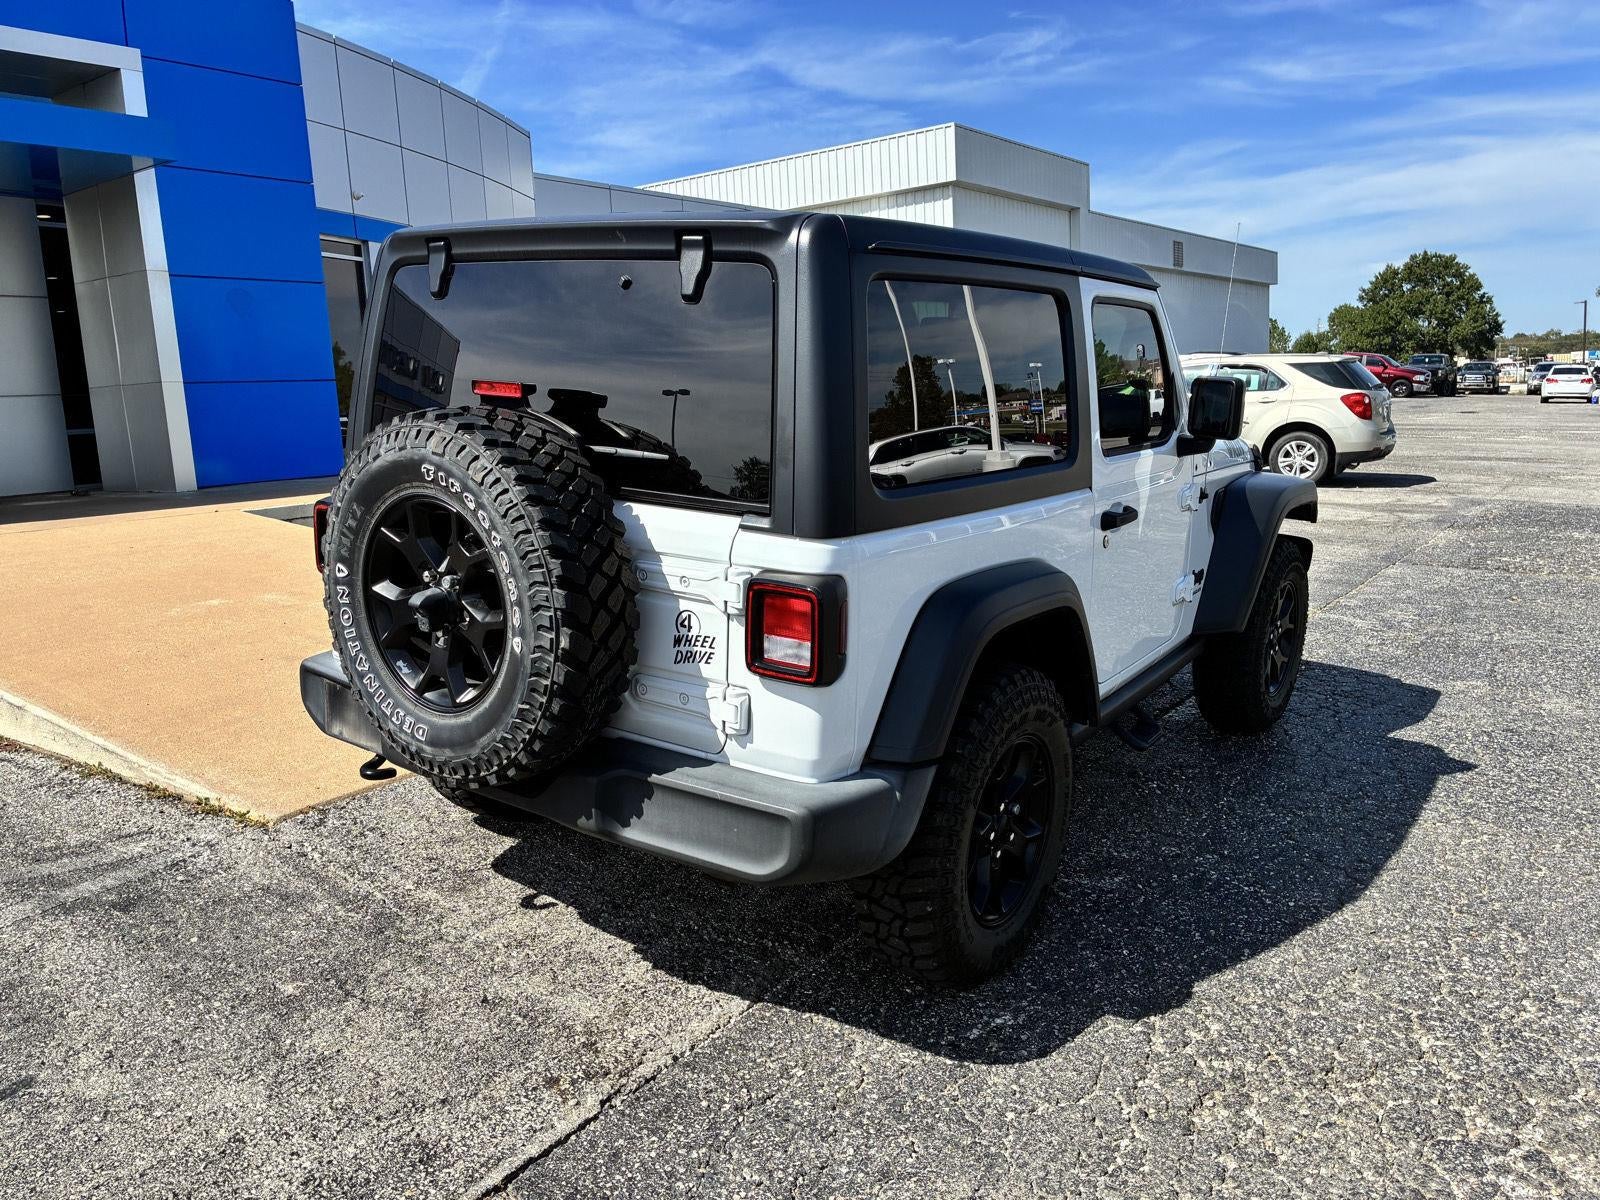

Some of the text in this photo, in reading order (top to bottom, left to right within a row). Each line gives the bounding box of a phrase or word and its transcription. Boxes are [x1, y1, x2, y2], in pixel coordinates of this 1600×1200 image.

[673, 634, 716, 650] WHEEL
[336, 586, 429, 741] DESTINATION
[673, 650, 715, 665] DRIVE
